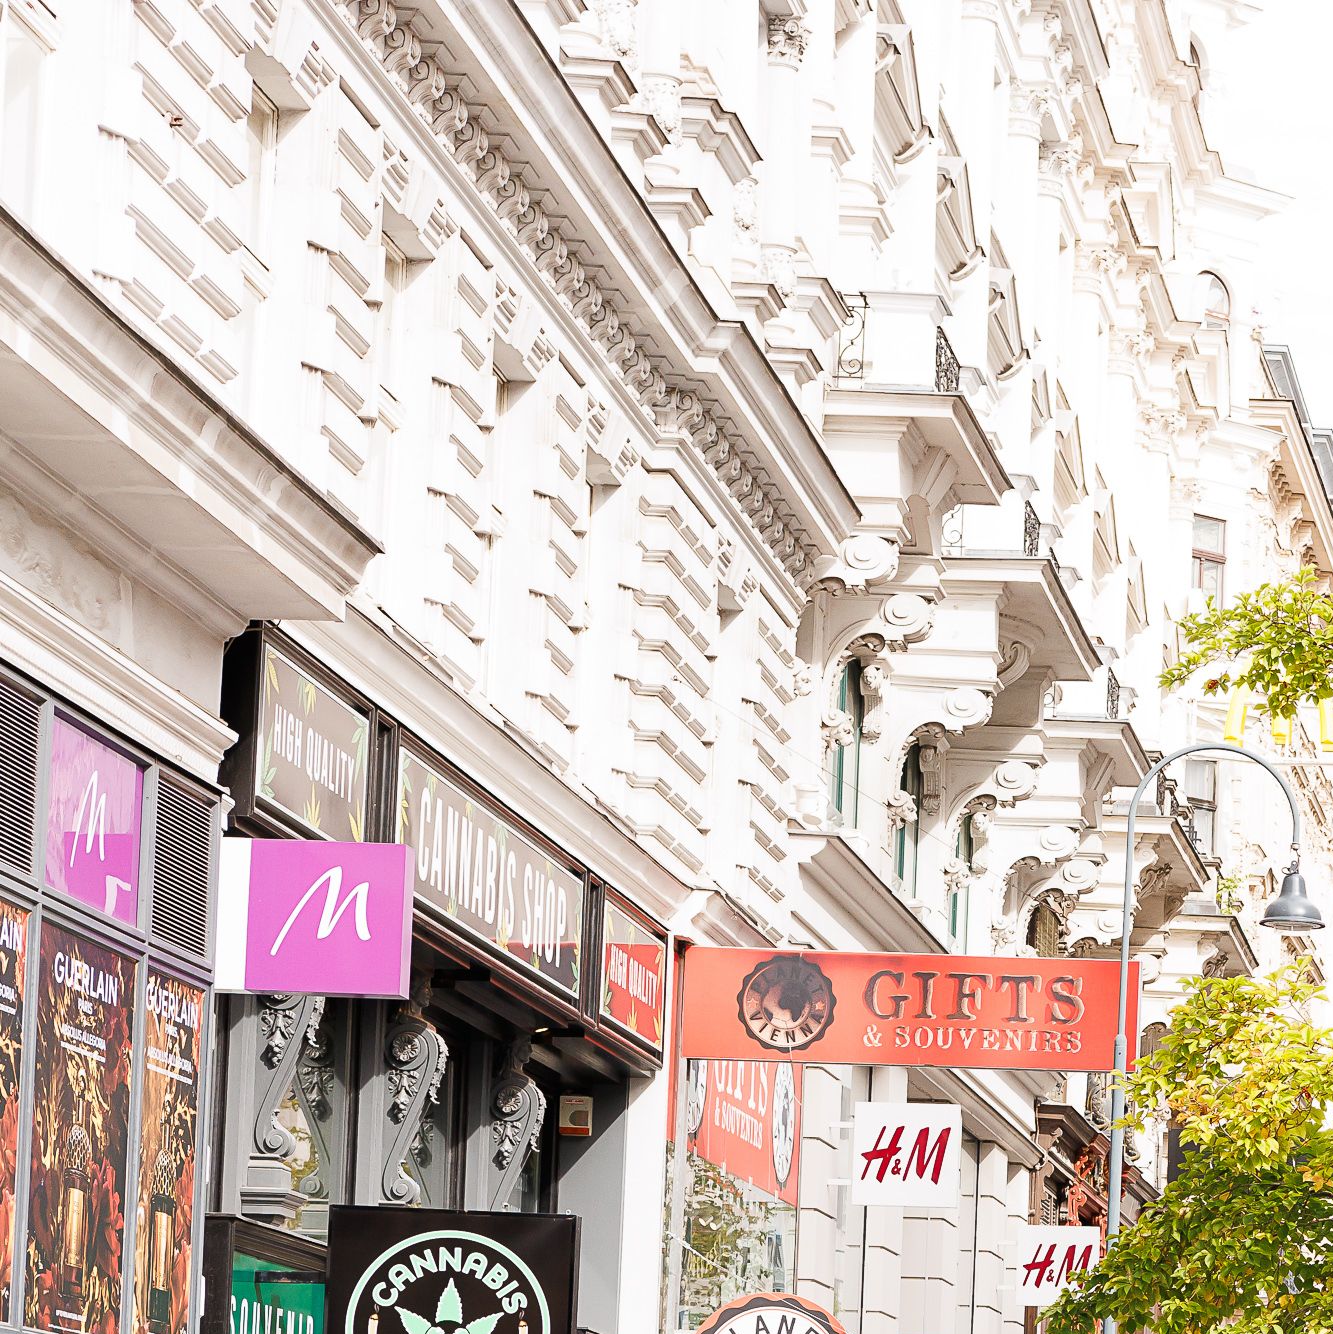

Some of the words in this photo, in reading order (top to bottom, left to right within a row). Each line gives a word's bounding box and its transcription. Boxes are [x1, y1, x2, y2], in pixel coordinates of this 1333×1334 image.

[274, 704, 302, 768] HIGH
[306, 728, 354, 803] QUALITY
[417, 787, 517, 938] CANNABIS
[521, 863, 567, 968] SHOP
[54, 952, 118, 1007] GUERLAIN
[146, 983, 199, 1027] GUERLAIN
[609, 944, 627, 990] HIGH
[628, 957, 657, 1009] QUALITY
[864, 969, 1086, 1026] GIFTS
[862, 1024, 882, 1049] &
[894, 1025, 1083, 1054] SOUVENIRS
[721, 1100, 763, 1151] SOUVENIRS
[861, 1125, 951, 1185] H&M
[372, 1246, 528, 1315] CANNABIS
